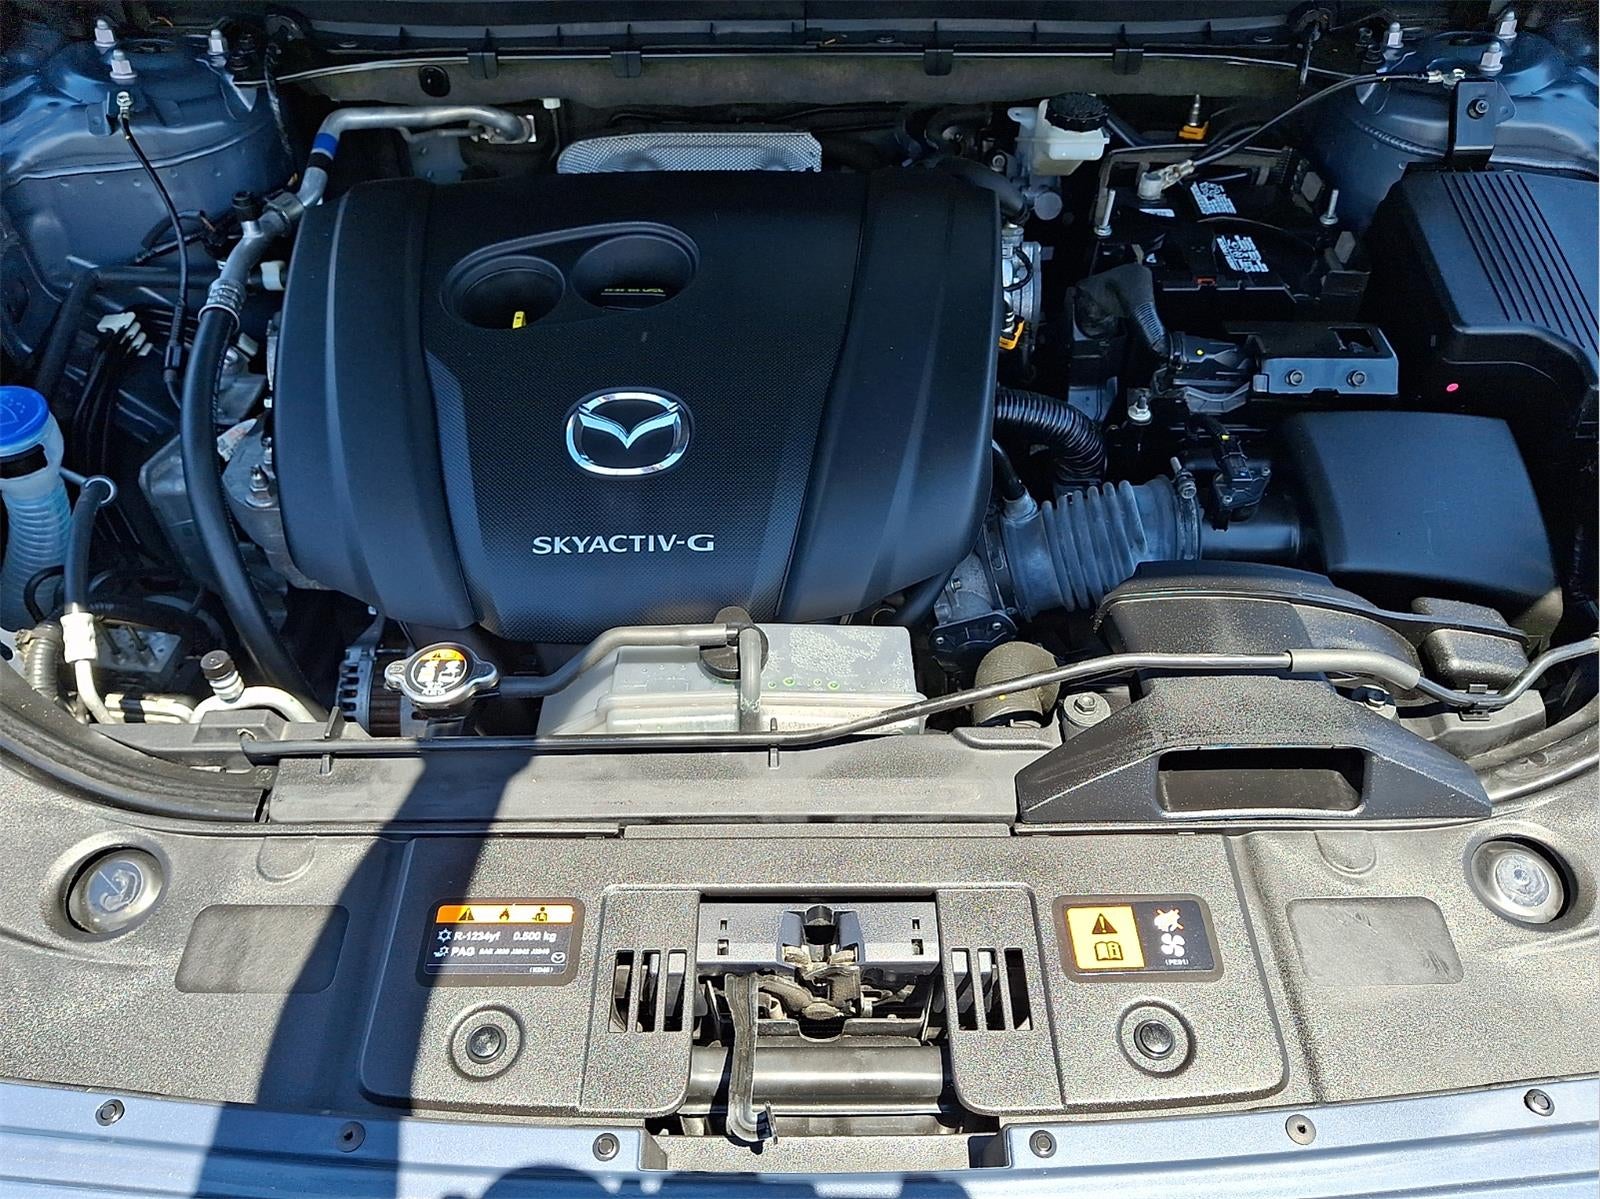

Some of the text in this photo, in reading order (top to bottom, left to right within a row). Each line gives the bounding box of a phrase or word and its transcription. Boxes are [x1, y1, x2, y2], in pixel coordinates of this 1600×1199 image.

[532, 534, 715, 554] SKYACTIV-G
[454, 931, 557, 943] R-1234yf 0.500 kg
[450, 946, 476, 957] PAG
